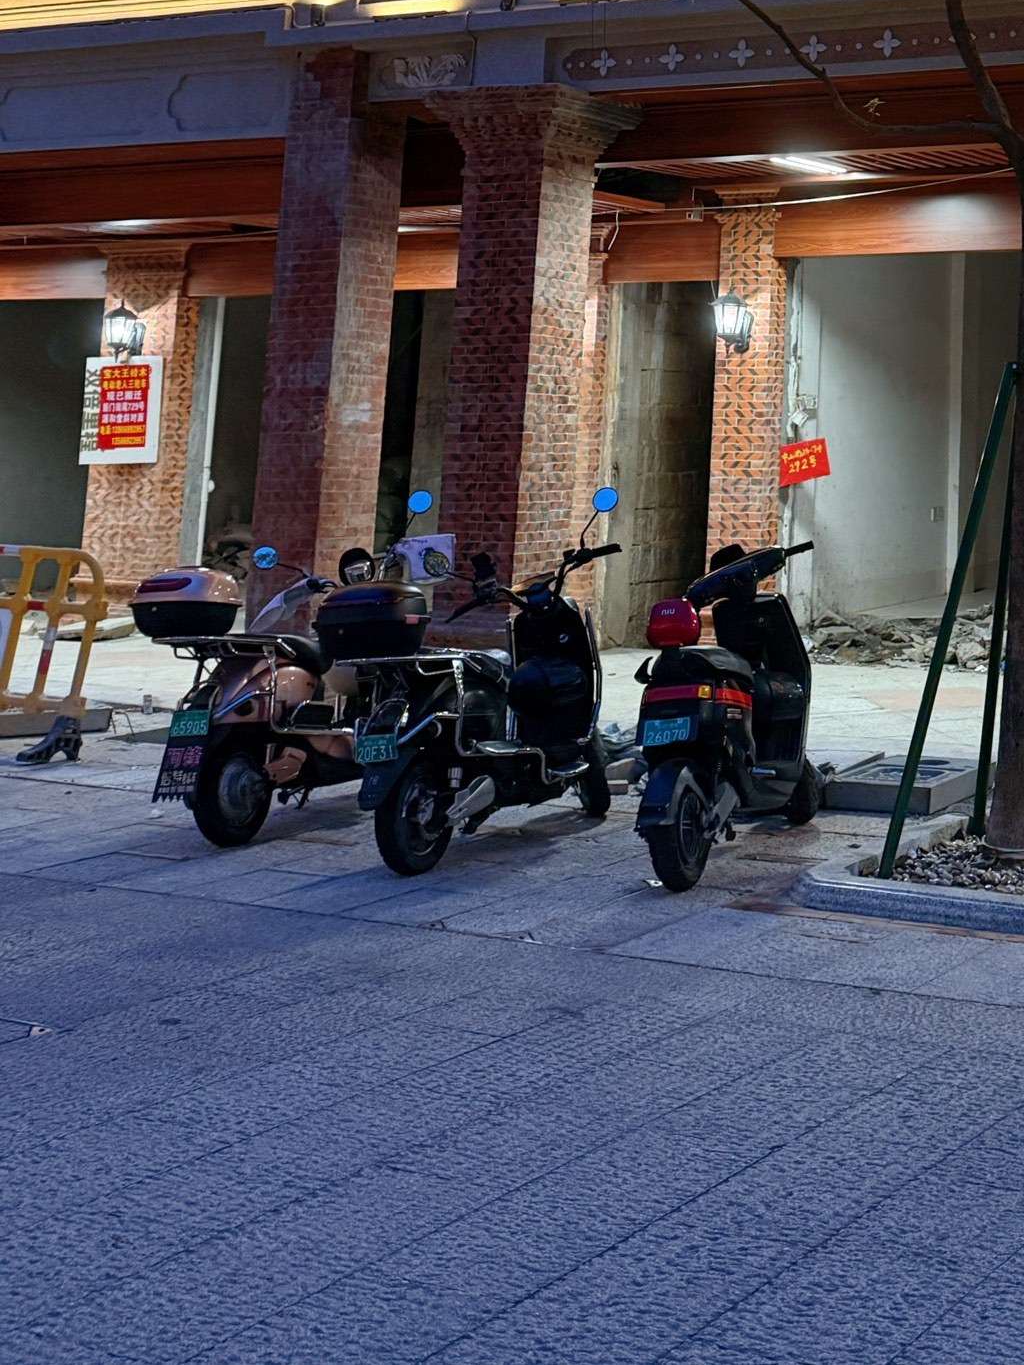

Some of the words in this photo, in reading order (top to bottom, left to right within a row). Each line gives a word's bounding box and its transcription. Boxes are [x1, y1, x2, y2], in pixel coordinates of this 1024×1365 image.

[172, 720, 207, 735] 65905
[647, 729, 686, 744] 26070
[358, 745, 393, 762] 20F31
